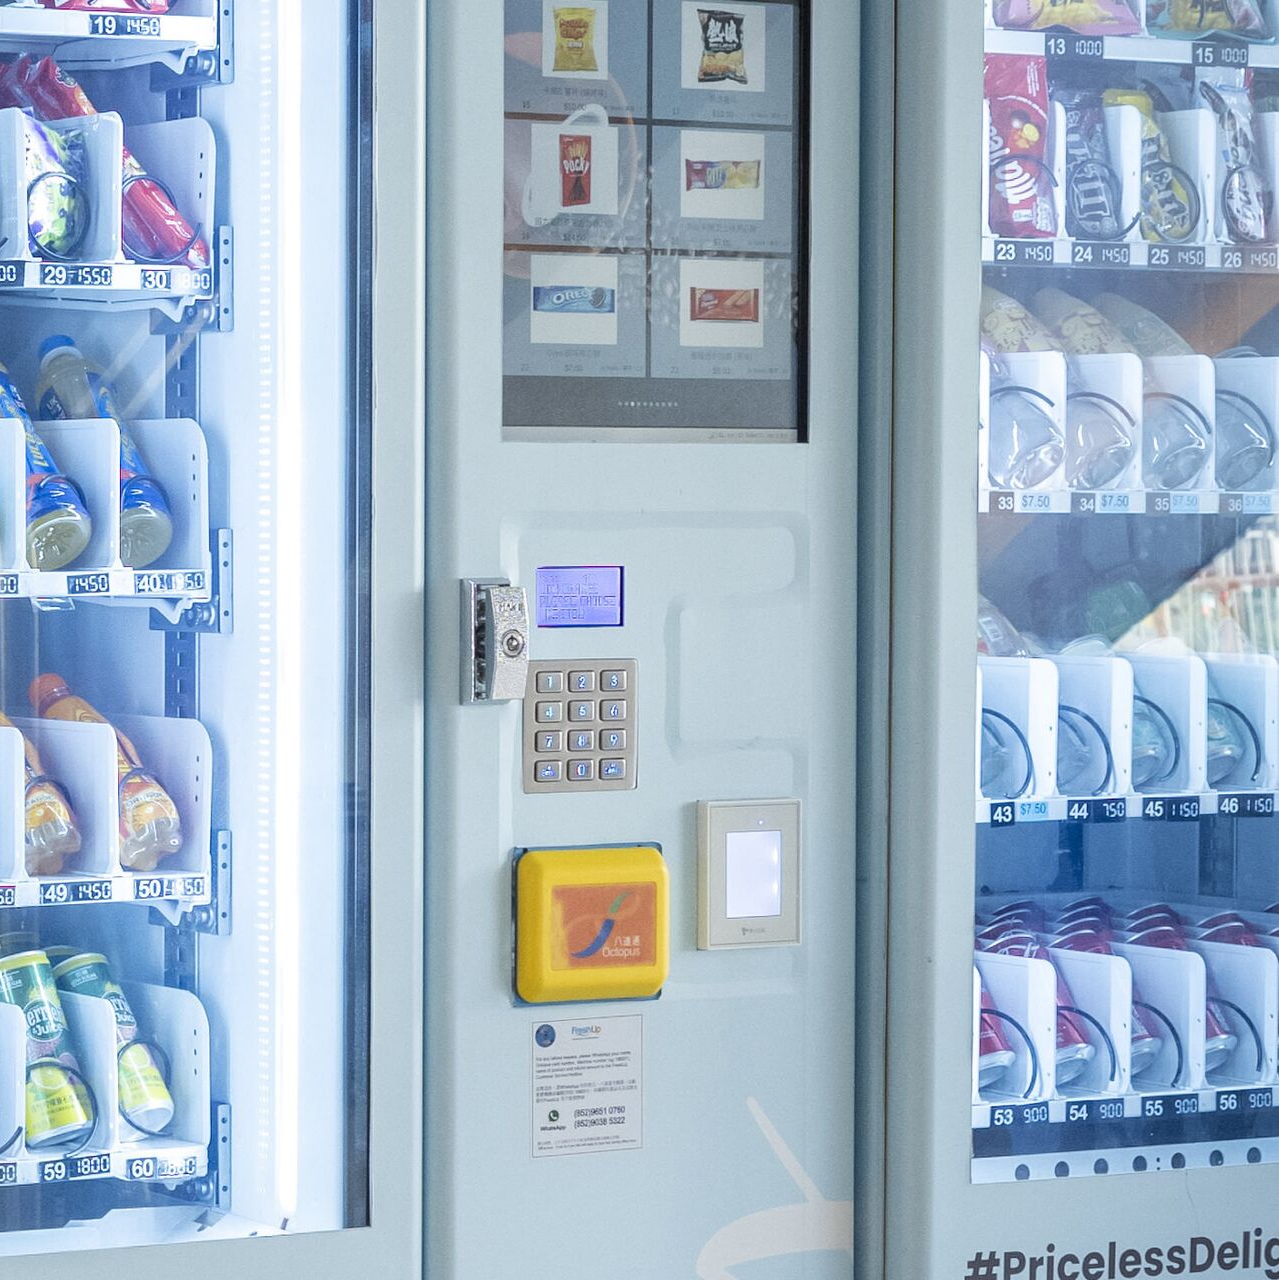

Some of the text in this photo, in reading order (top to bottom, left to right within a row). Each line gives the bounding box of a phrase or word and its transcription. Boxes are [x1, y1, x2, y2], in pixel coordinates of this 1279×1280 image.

[95, 18, 115, 34] 19
[1048, 39, 1066, 55] 13
[1196, 47, 1213, 63] 15
[997, 244, 1016, 260] 23
[1075, 246, 1093, 262] 24
[1151, 248, 1169, 265] 25
[1224, 252, 1241, 268] 26
[45, 267, 66, 284] 29
[145, 271, 166, 288] 30
[552, 289, 589, 305] OREO
[998, 494, 1050, 510] 33 $7.50
[1080, 494, 1129, 511] 34 $7.50
[1155, 494, 1198, 511] 35 $7.50
[1228, 494, 1271, 512] 36 $7.50
[138, 575, 158, 591] 40
[547, 675, 618, 688] 1 2 3
[578, 705, 587, 716] 5
[610, 705, 618, 716] 6
[545, 734, 618, 748] 7 8 9
[1070, 804, 1088, 819] 44
[1145, 802, 1163, 816] 45
[1220, 798, 1238, 812] 46
[993, 806, 1011, 822] 43
[46, 885, 67, 901] 49
[139, 880, 161, 897] 50
[602, 946, 641, 959] Octopus
[1145, 1100, 1163, 1116] 55
[1220, 1095, 1237, 1111] 56
[994, 1109, 1013, 1126] 53
[1069, 1105, 1088, 1120] 54
[44, 1162, 65, 1179] 59
[132, 1161, 153, 1177] 60
